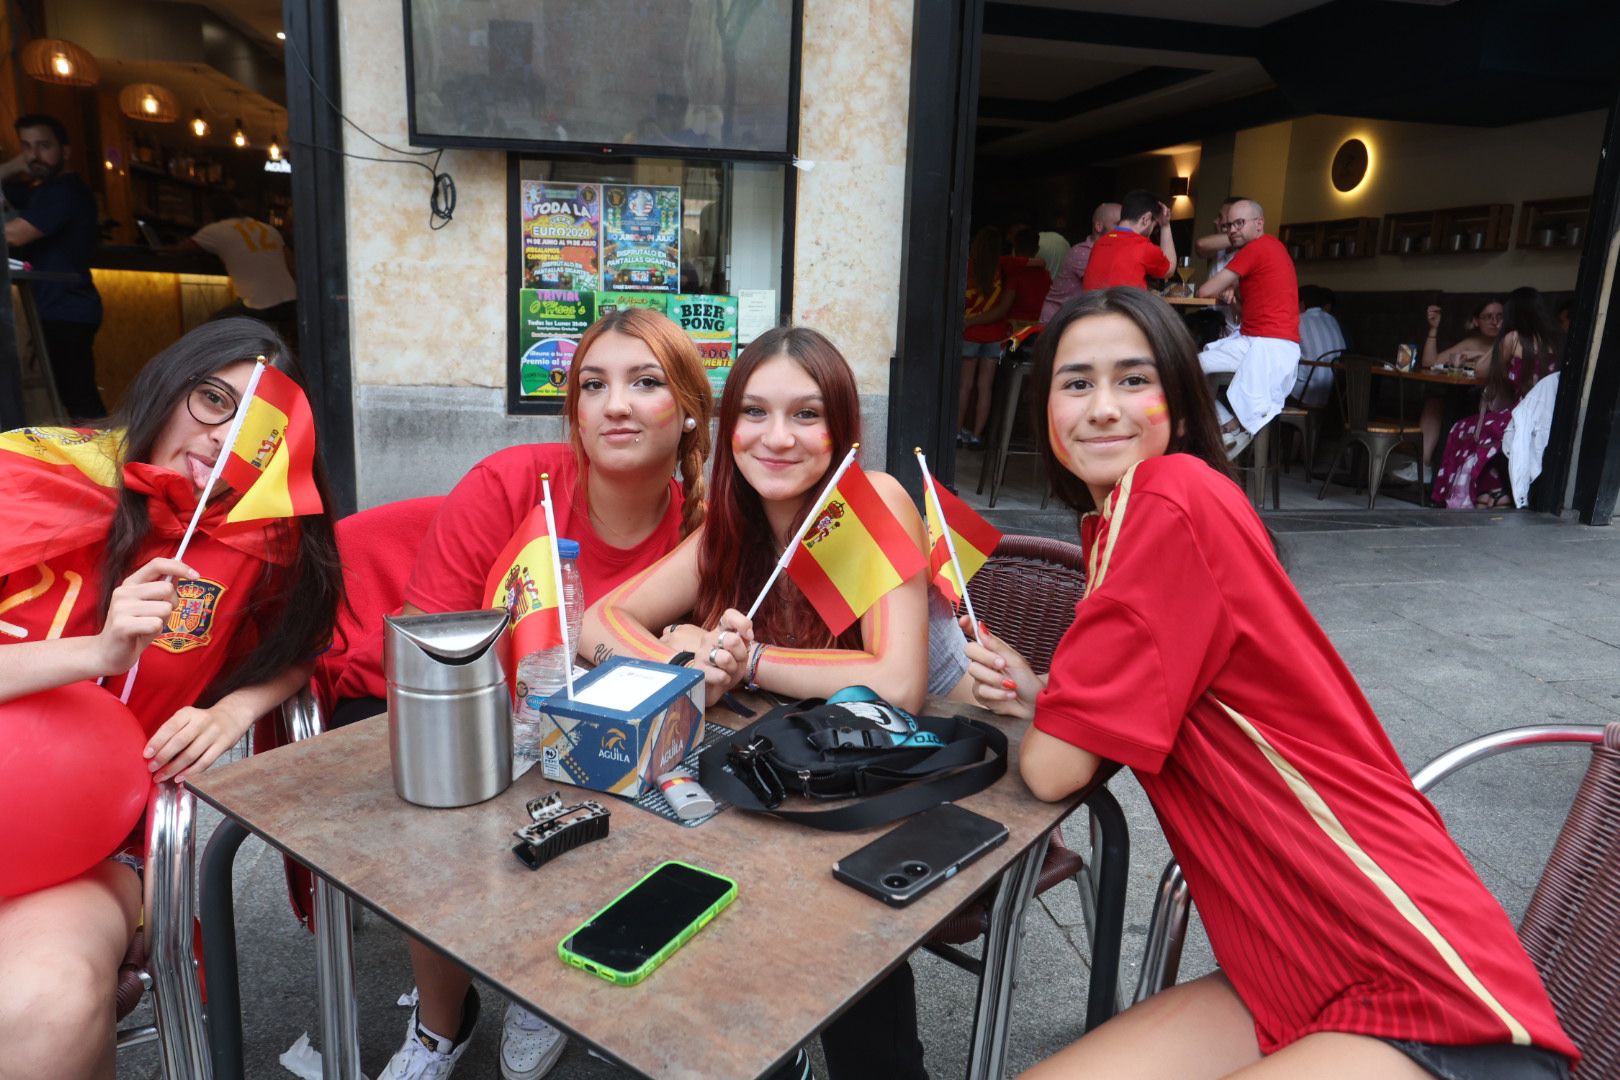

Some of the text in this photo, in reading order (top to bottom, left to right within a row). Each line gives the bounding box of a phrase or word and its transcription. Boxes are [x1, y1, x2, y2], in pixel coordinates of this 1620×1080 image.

[533, 201, 592, 219] TODA LA
[681, 303, 726, 319] BEER
[680, 316, 725, 332] PONG
